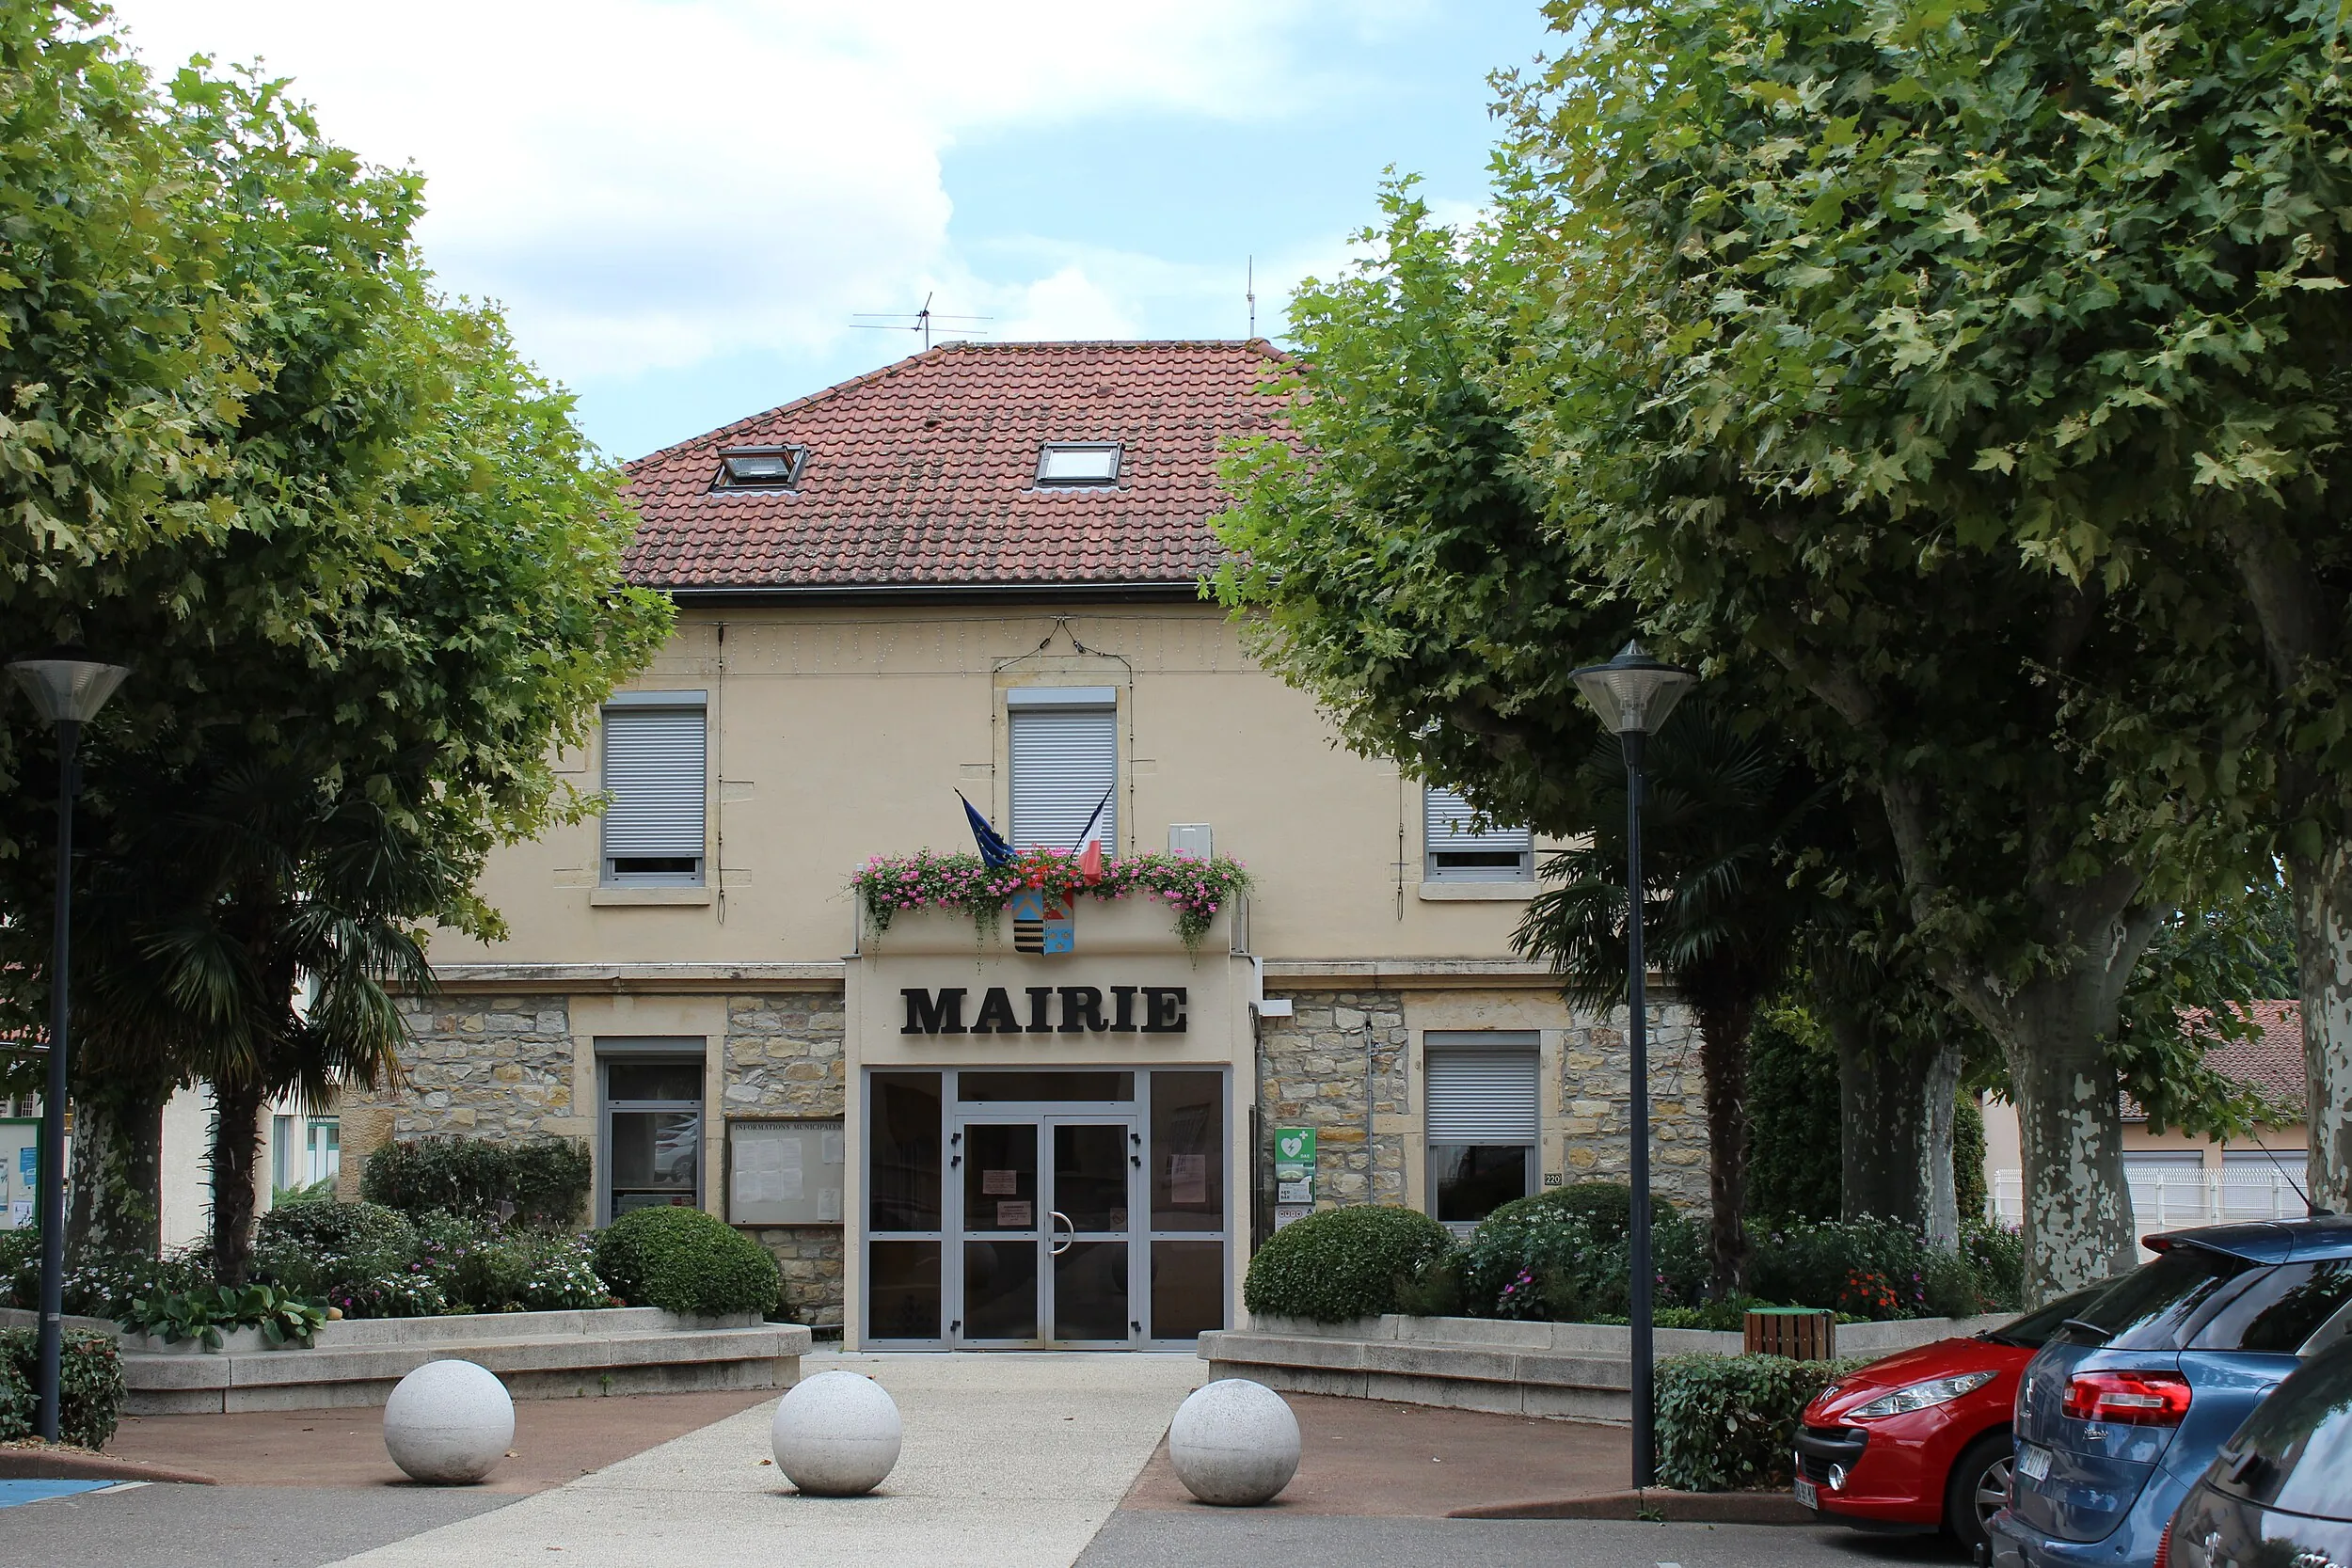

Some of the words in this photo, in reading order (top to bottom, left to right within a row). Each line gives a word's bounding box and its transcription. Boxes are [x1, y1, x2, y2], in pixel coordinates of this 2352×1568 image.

[899, 986, 1188, 1035] MAIRIE
[735, 1123, 790, 1132] INFORMATIONS
[794, 1123, 842, 1132] MUNICIPALES
[1546, 1175, 1560, 1183] 220
